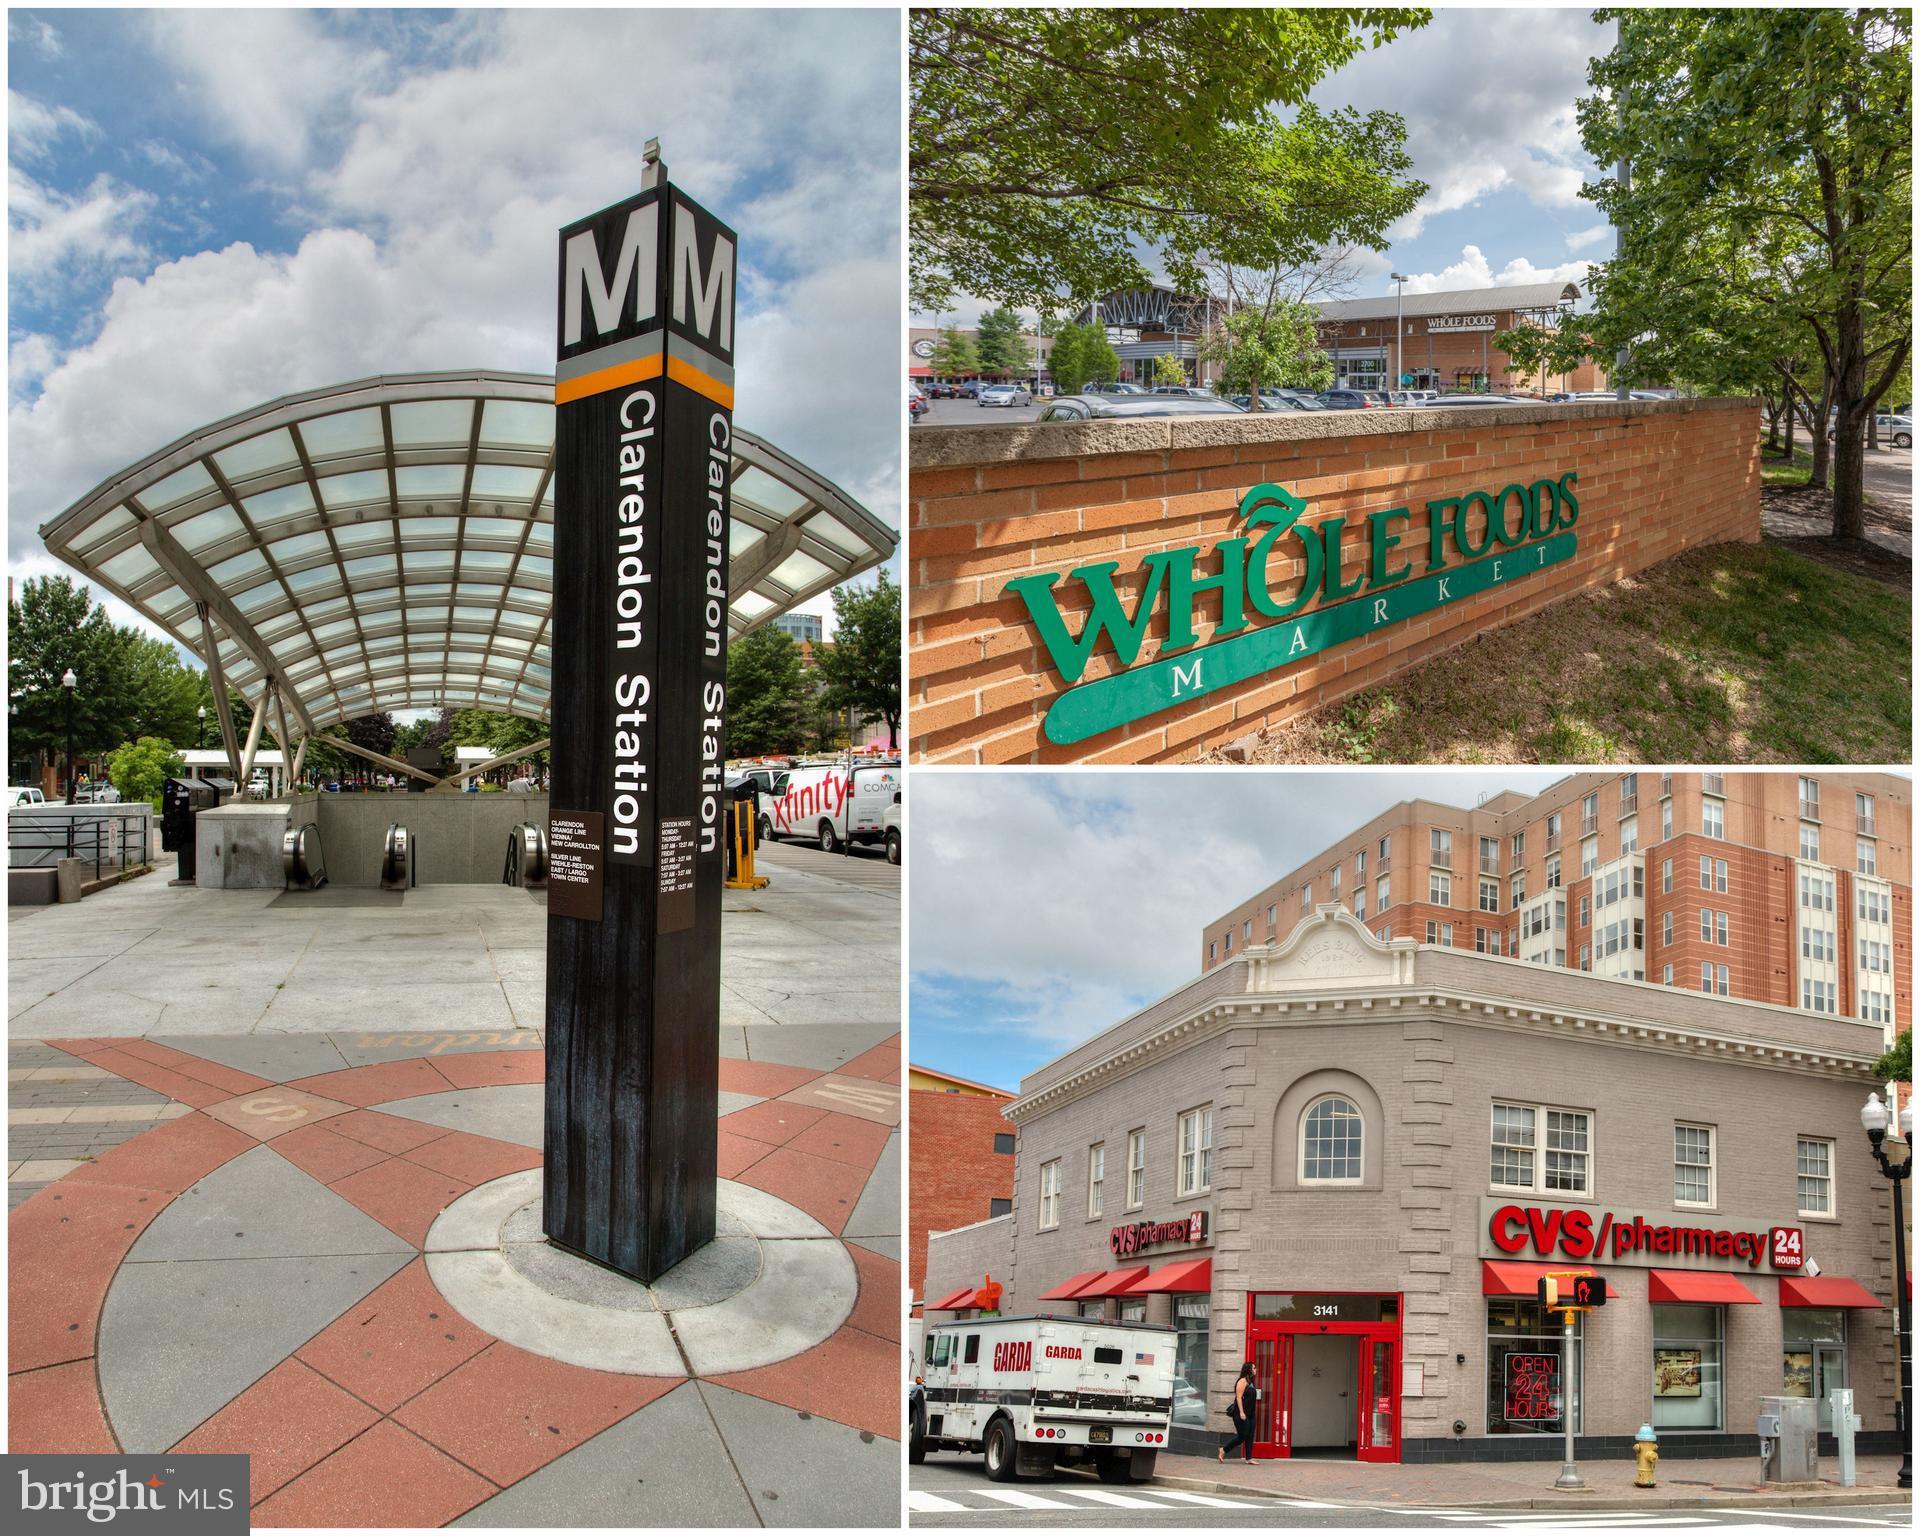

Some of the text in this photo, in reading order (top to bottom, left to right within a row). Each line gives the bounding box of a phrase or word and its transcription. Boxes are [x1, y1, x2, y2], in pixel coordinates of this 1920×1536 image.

[564, 201, 658, 346] M
[673, 201, 733, 352] M
[1427, 315, 1496, 328] WHOLE FOODS
[1006, 472, 1579, 682] WHOLE FOODS
[613, 390, 656, 854] Clarendon Station
[700, 412, 730, 852] Clarendon Station
[1171, 546, 1546, 697] MARKET
[773, 771, 848, 833] xfinity
[552, 820, 584, 828] CLARENDON
[564, 842, 600, 850] CARROLLTON
[551, 860, 594, 870] WIEHLE-RESTON
[567, 875, 588, 884] CENTER
[1192, 1213, 1202, 1231] 24
[1490, 1205, 1768, 1266] CVS/pharmacy
[1774, 1230, 1800, 1254] 24
[1775, 1256, 1801, 1266] HOURS
[1314, 1306, 1338, 1316] 3141
[994, 1341, 1032, 1372] GARDA
[1046, 1346, 1082, 1360] GARDA
[1512, 1356, 1554, 1374] OPEN
[1515, 1374, 1550, 1400] 24
[1506, 1400, 1558, 1418] HOURS
